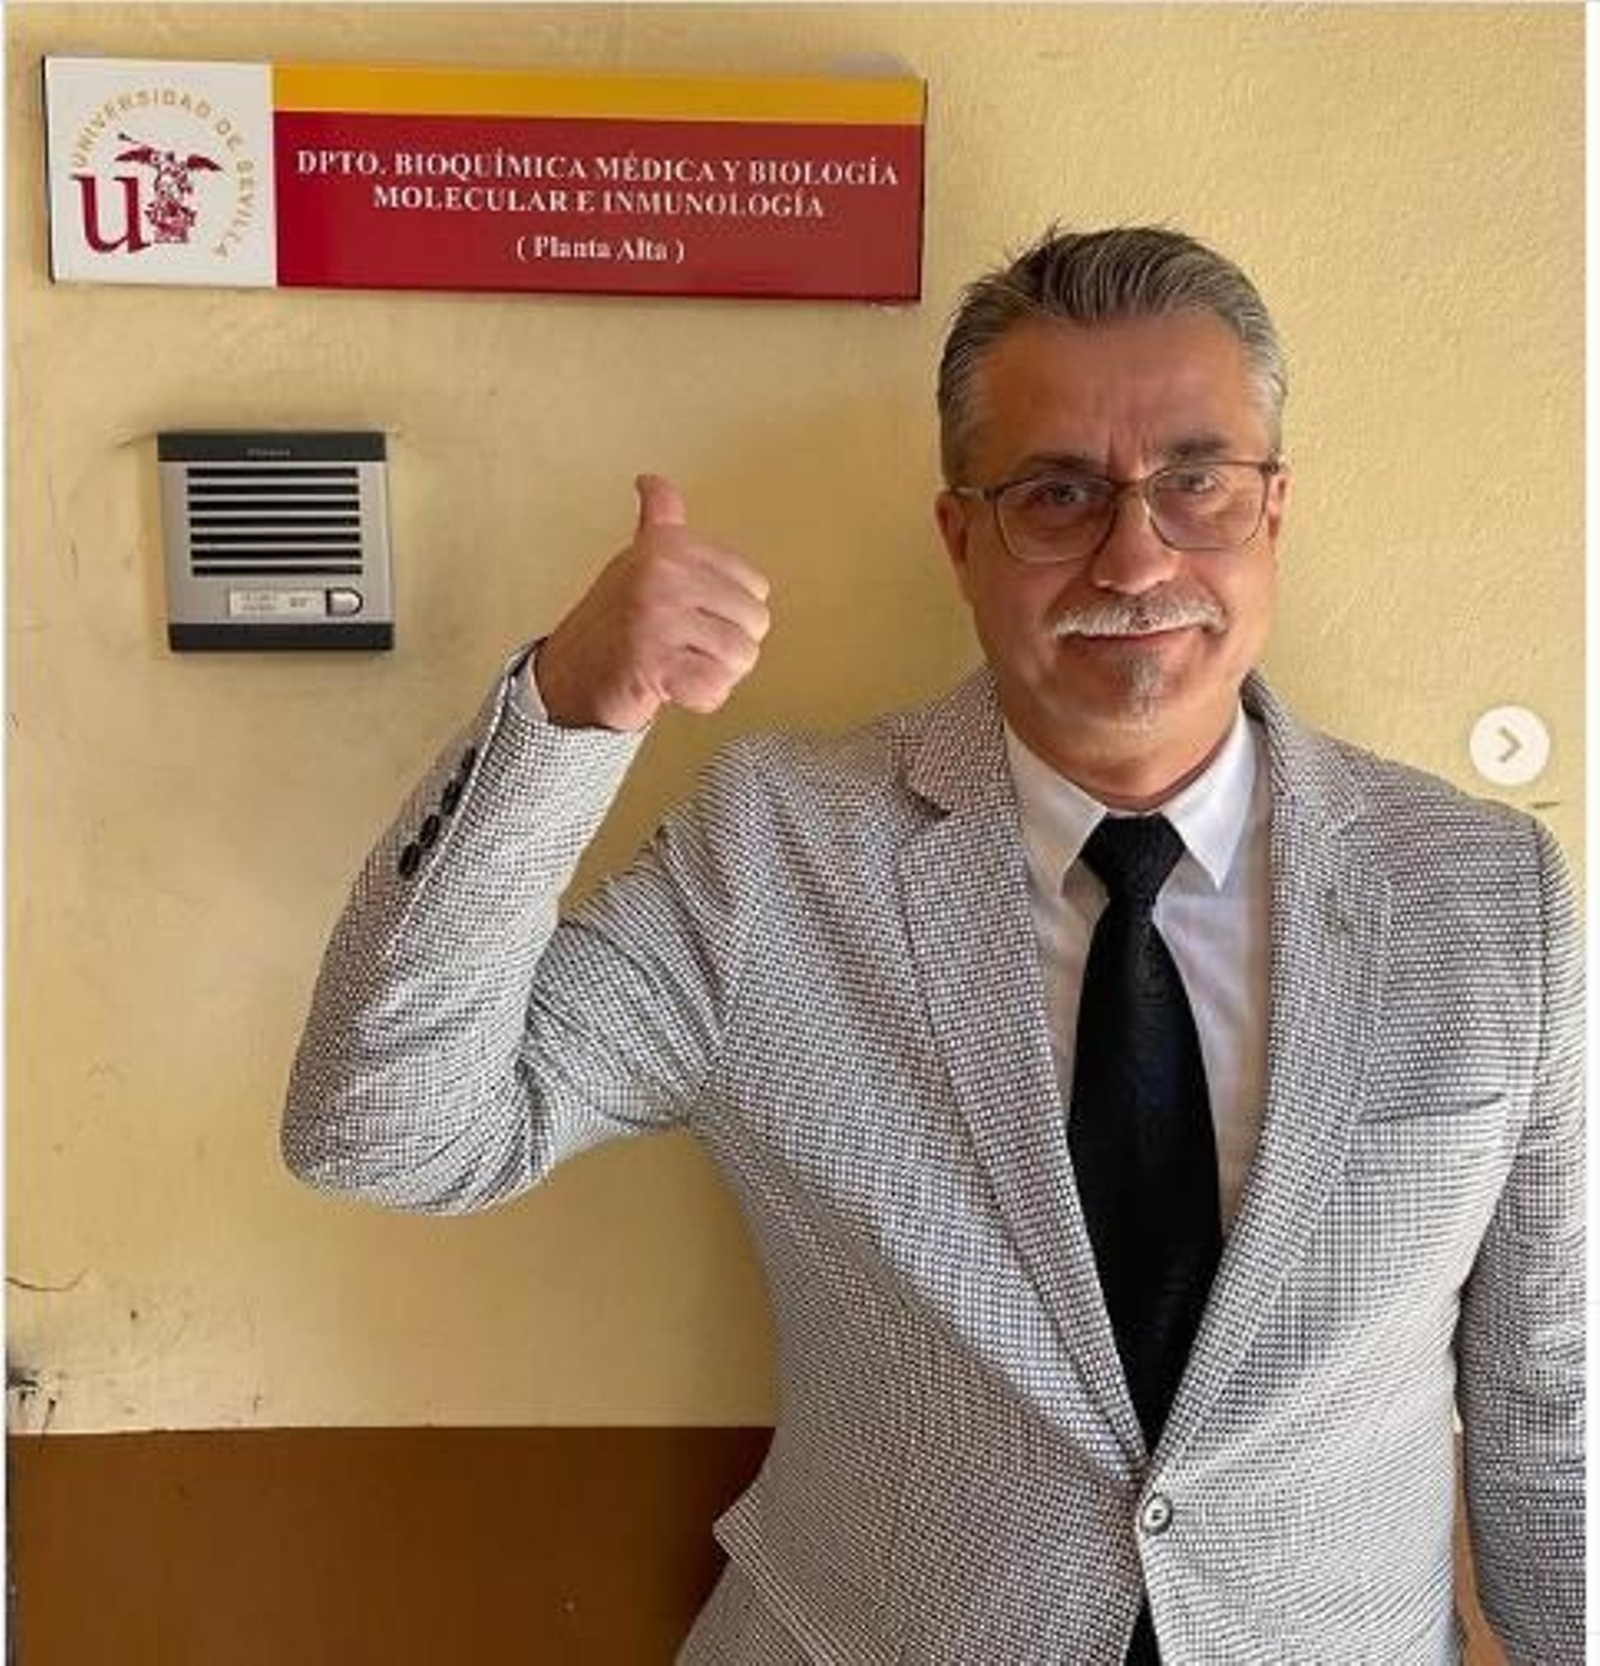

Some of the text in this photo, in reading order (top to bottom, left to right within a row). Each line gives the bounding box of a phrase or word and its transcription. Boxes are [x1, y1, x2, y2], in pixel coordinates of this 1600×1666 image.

[73, 89, 254, 258] UNIVERSIDAD DE SEVILLA
[297, 148, 899, 186] DPTO. BIOQUÍMICA MÉDICA Y BIOLOGÍA
[373, 185, 825, 219] MOLECULAR E INMUNOLOGÍA
